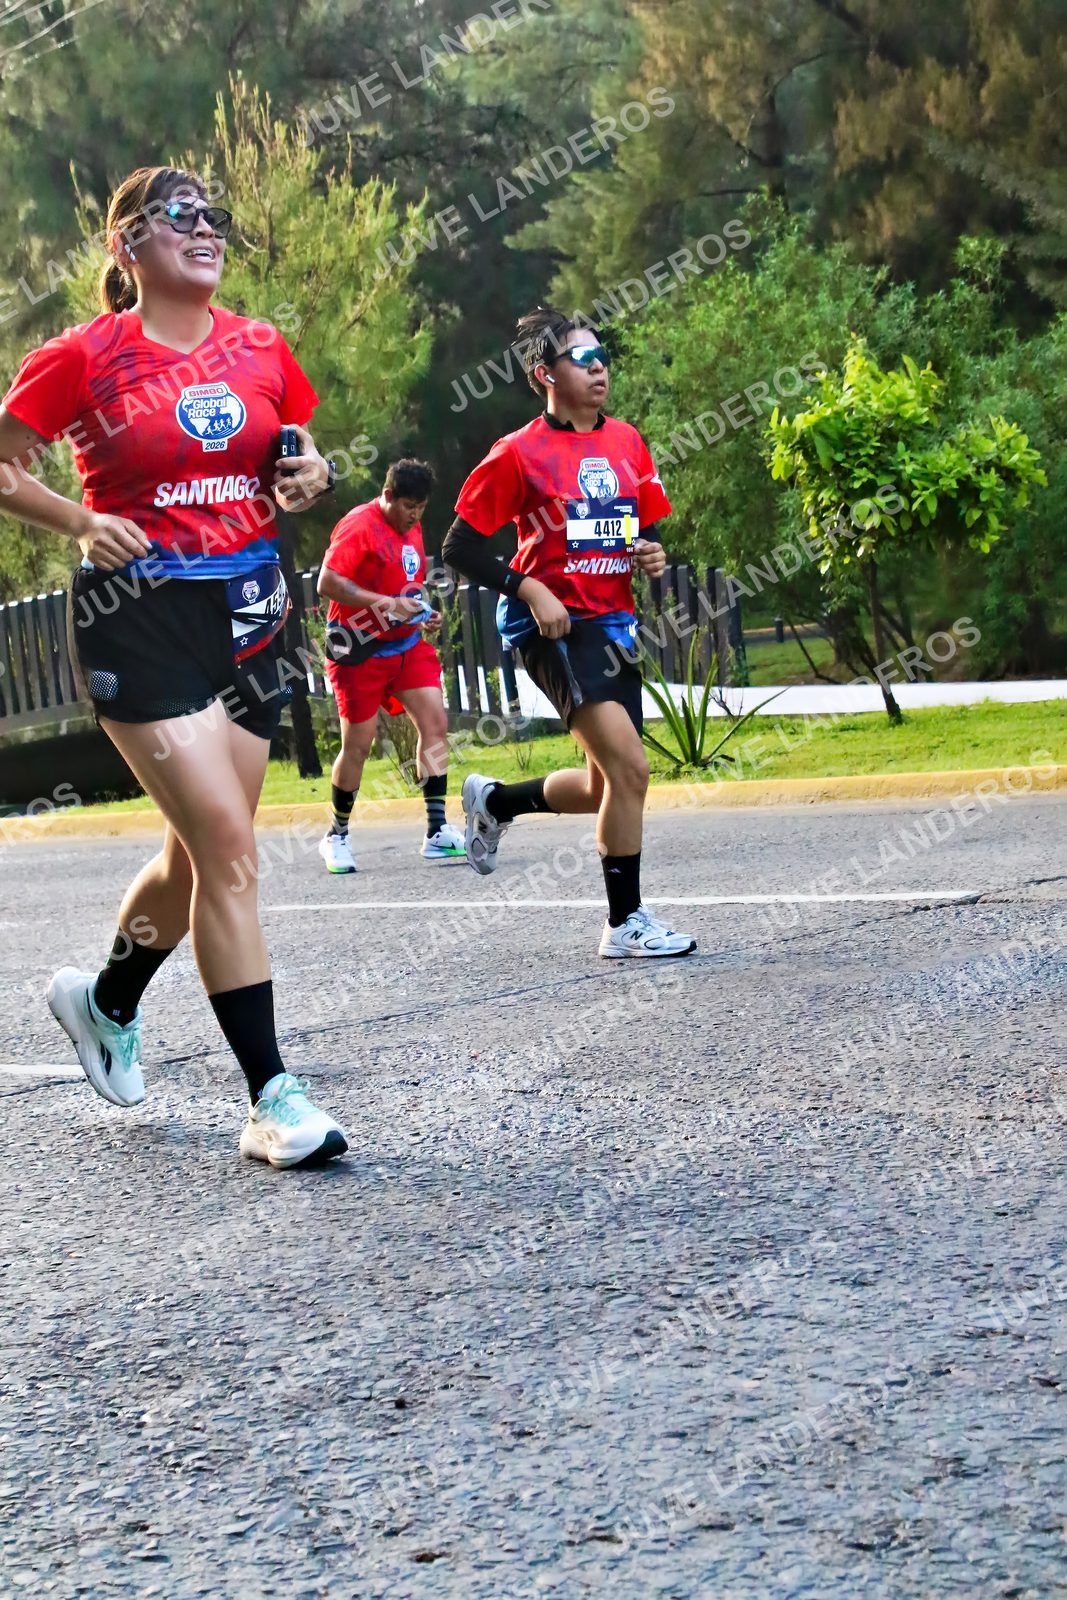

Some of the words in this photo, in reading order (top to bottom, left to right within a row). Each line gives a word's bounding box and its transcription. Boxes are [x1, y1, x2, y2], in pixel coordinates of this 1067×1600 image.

[188, 387, 224, 397] BIMBO
[192, 397, 227, 409] Global
[187, 407, 216, 418] Race
[205, 441, 225, 450] 2026
[153, 475, 261, 507] SANTIAGO
[594, 520, 622, 537] 4412
